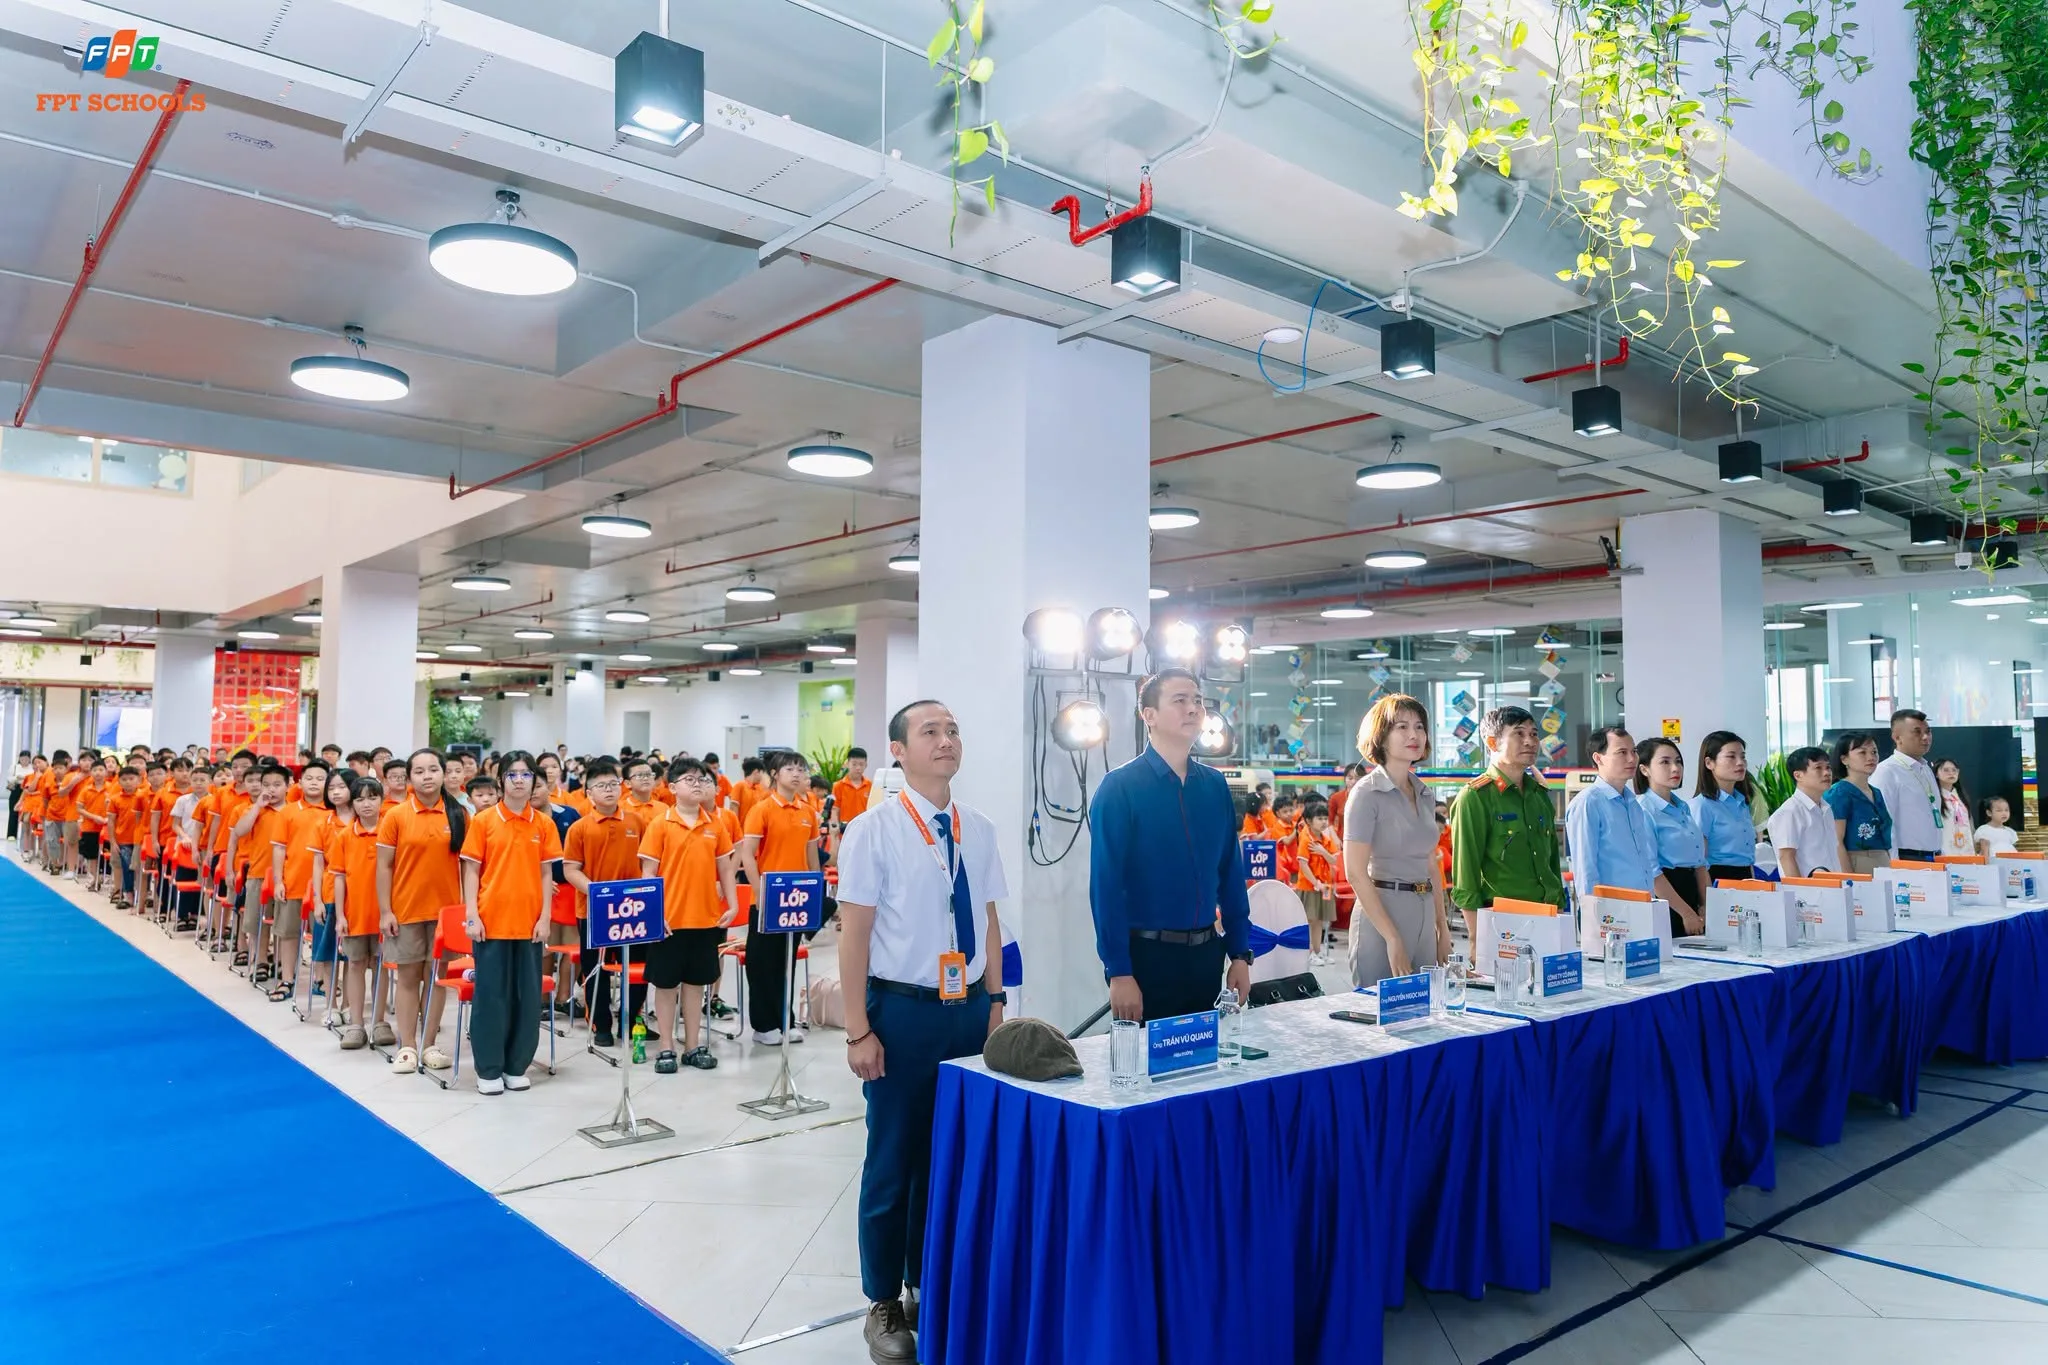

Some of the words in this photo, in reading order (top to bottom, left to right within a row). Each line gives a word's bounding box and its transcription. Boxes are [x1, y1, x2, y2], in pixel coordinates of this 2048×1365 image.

[1250, 850, 1268, 864] LỚP
[1251, 866, 1268, 877] 6A1
[779, 888, 809, 907] LỚP
[607, 896, 646, 920] LỚP
[778, 911, 808, 928] 6A3
[608, 921, 648, 941] 6A4
[1190, 1030, 1213, 1042] QUANG
